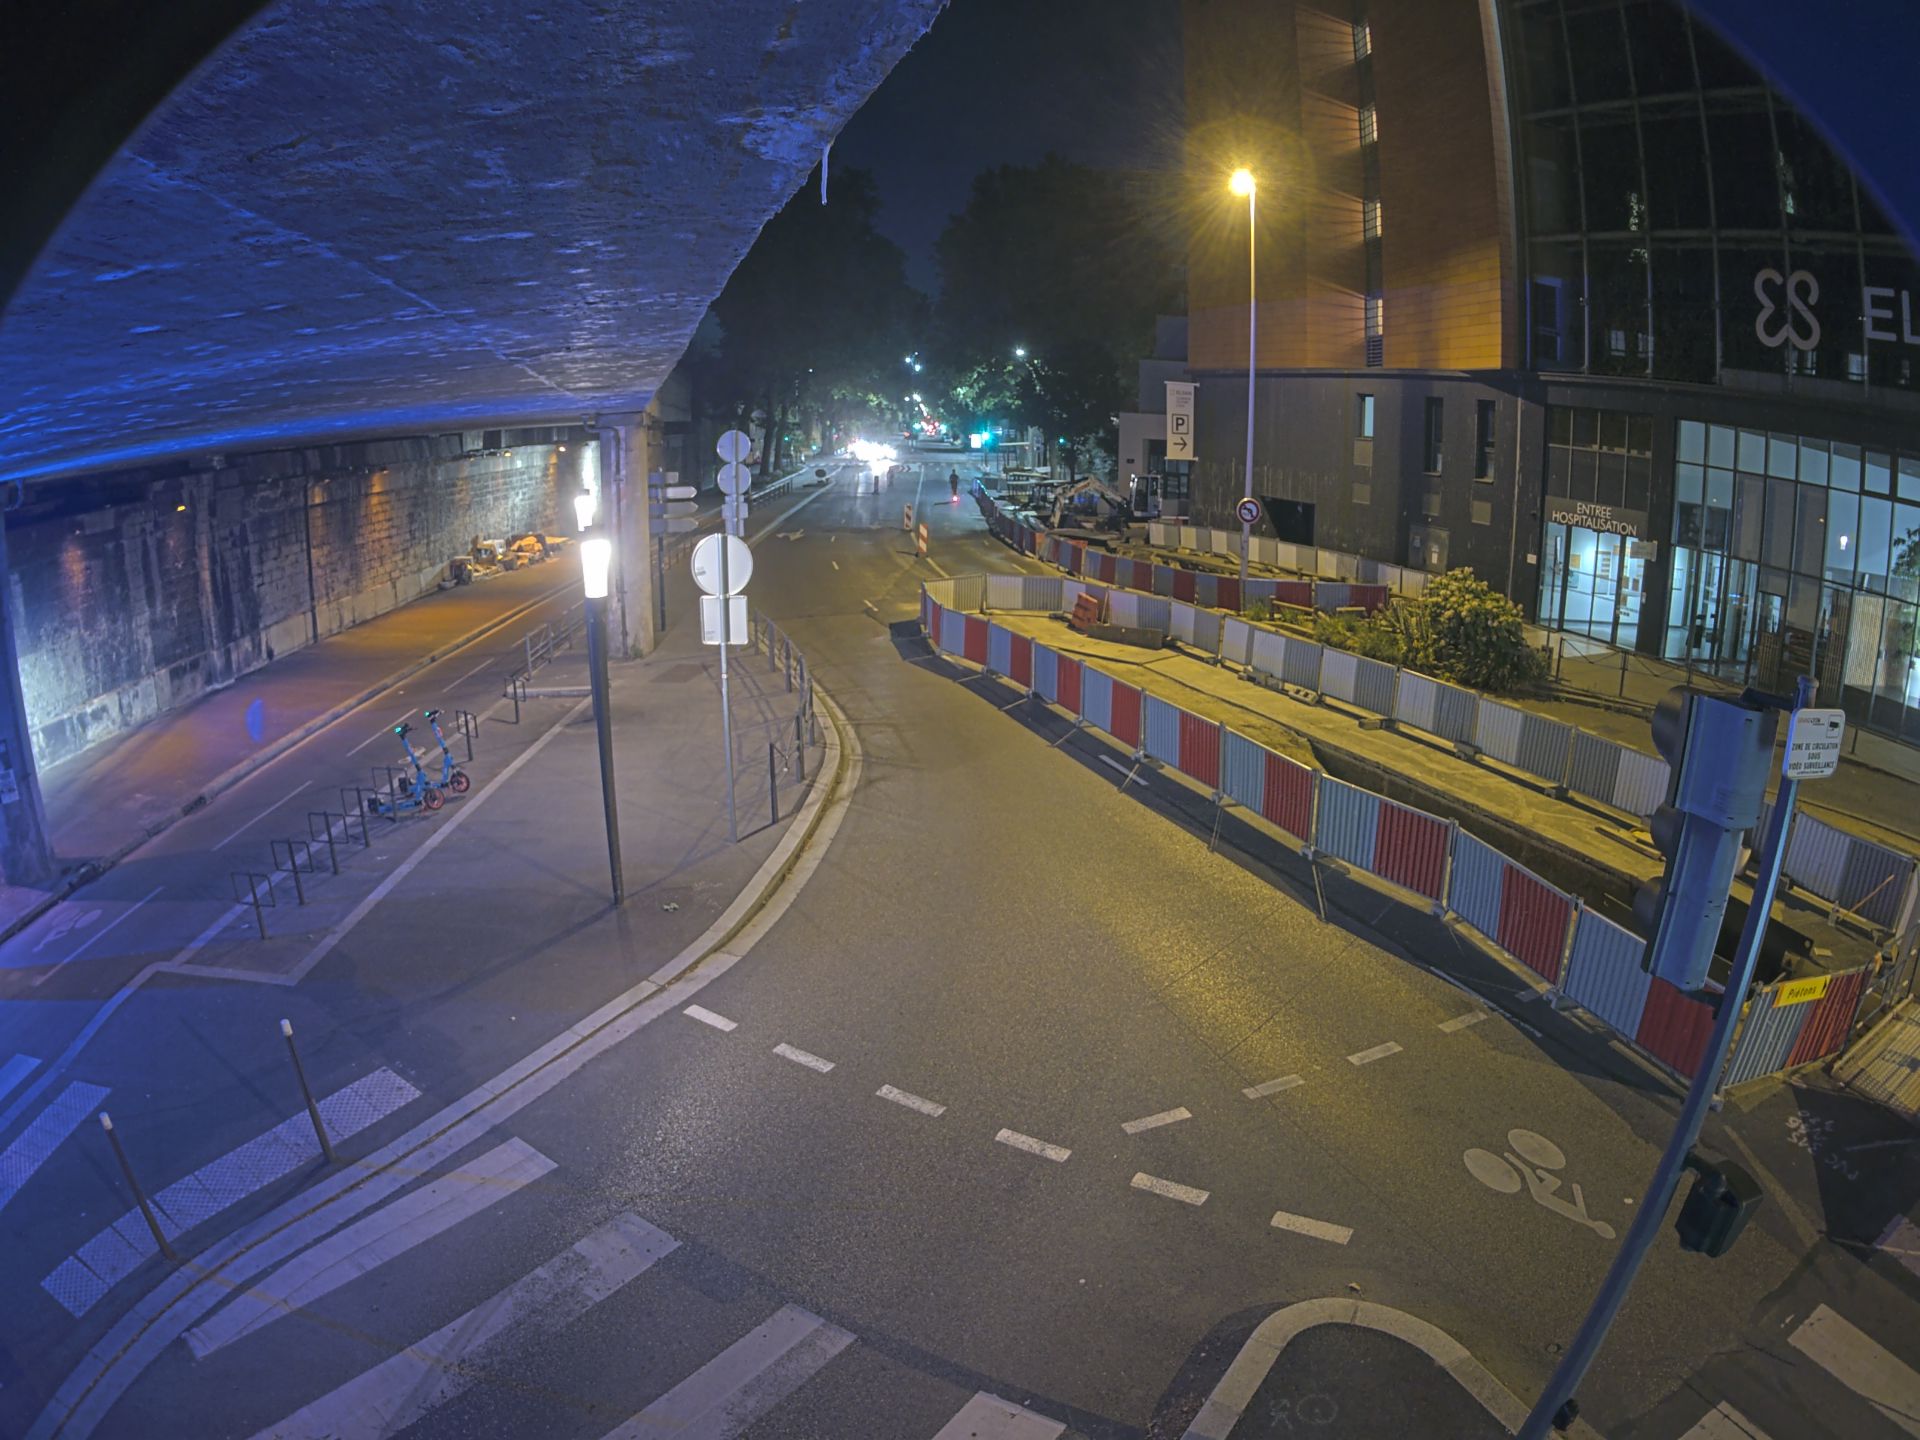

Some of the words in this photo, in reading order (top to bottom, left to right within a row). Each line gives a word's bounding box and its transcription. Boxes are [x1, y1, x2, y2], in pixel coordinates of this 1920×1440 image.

[1863, 286, 1920, 344] EL
[1175, 417, 1185, 431] P
[1552, 510, 1637, 536] HOSPITALISATION
[1792, 743, 1804, 751] ZONE
[1805, 743, 1811, 751] DE
[1808, 752, 1821, 760] SOUS
[1803, 761, 1834, 769] SURVEILLANCE
